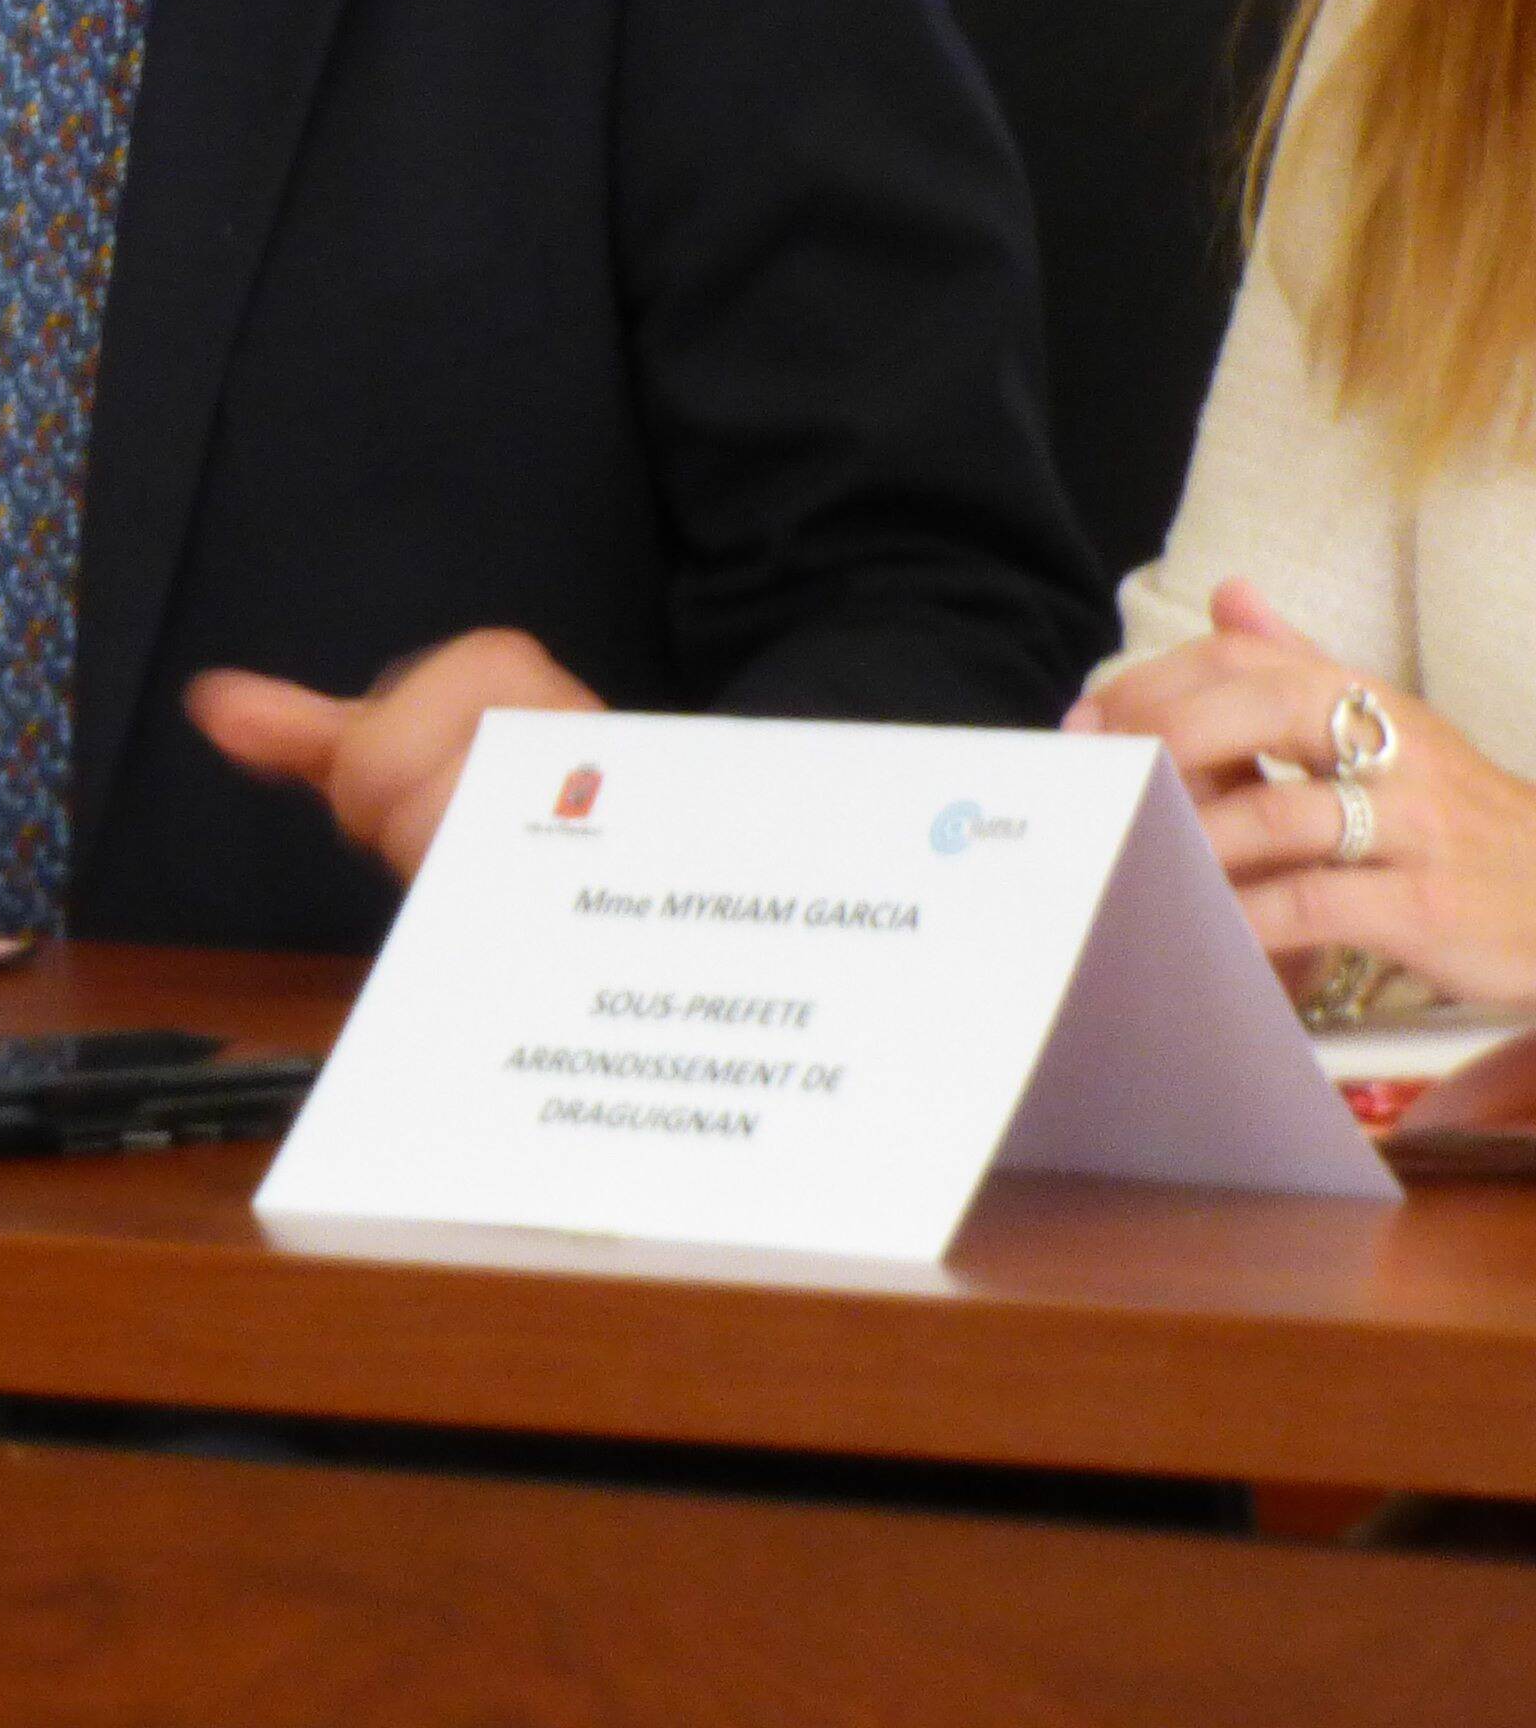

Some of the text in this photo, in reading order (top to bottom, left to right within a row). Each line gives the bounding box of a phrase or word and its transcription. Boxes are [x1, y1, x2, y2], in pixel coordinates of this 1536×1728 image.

[572, 886, 921, 932] Mme MYRIAM GARCIA
[504, 1044, 845, 1094] ARRONDISSEMENT DE
[538, 1096, 760, 1139] DRAGUIGNAN
